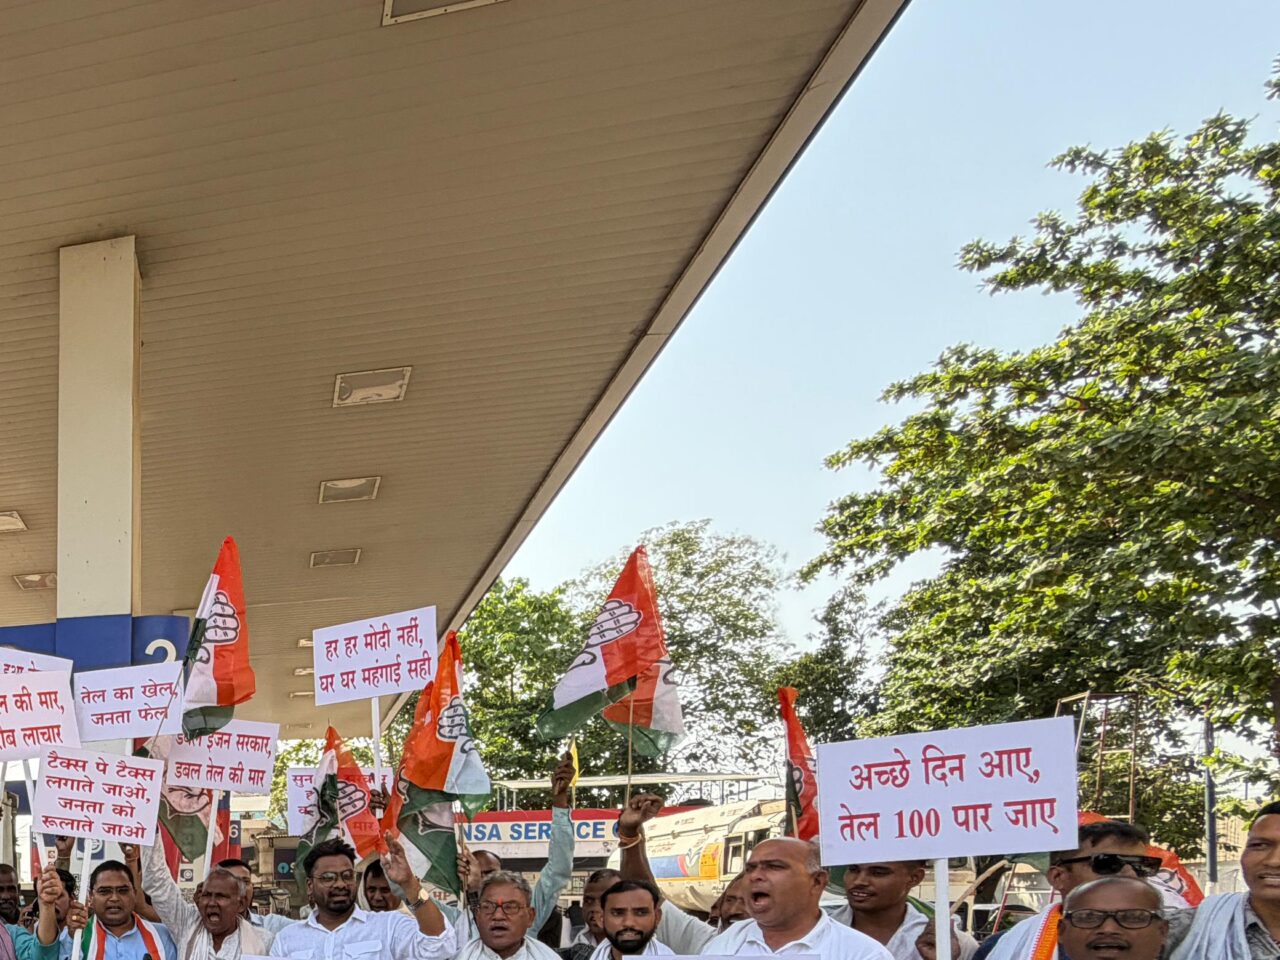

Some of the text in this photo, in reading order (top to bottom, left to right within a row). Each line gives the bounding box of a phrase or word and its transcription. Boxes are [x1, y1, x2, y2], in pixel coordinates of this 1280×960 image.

[325, 617, 422, 662] हर हर मोदी नहीं,
[319, 650, 431, 693] घर घर महंगाई सही
[12, 686, 32, 712] की
[37, 691, 64, 714] मार,
[81, 679, 178, 704] तेल का खेल,
[91, 703, 168, 725] जनता फेल
[21, 725, 63, 746] लाचार
[236, 734, 271, 758] सरकार,
[48, 751, 156, 781] टैक्स पे टैक्स
[175, 757, 266, 787] डबल तेल की मार
[849, 744, 1040, 792] अच्छे दिन आए,
[46, 775, 150, 804] लगाते जाओ,
[58, 797, 136, 818] जनता को
[838, 798, 1059, 842] तेल 100 पार जाए
[42, 815, 146, 838] रूलाते जाओ
[230, 824, 238, 838] 6
[510, 822, 606, 840] SERCE
